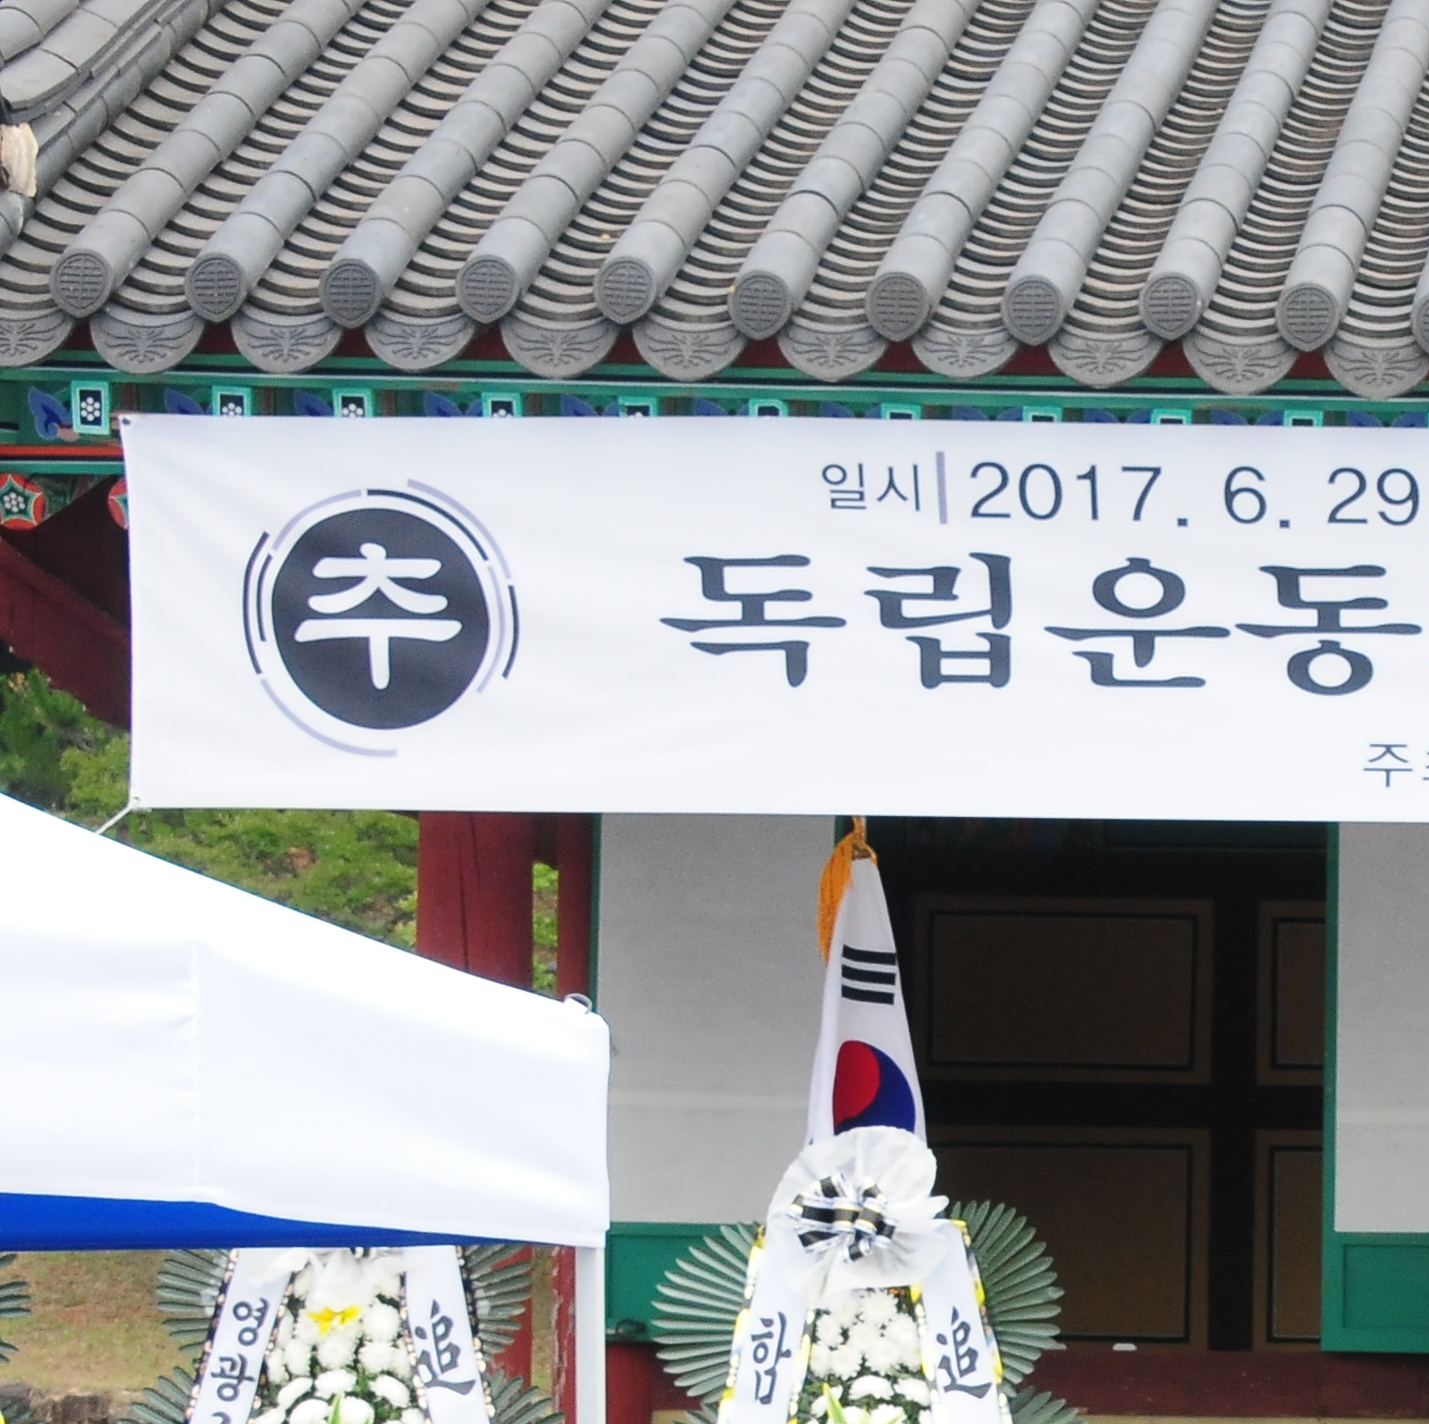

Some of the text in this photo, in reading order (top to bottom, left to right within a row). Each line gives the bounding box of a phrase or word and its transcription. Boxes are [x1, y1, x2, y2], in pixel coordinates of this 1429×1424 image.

[820, 461, 922, 511] 일시
[971, 461, 1187, 528] 2017.
[1225, 466, 1290, 530] 6.
[296, 541, 463, 691] 추
[414, 1299, 477, 1395] 追
[936, 1306, 993, 1399] 追
